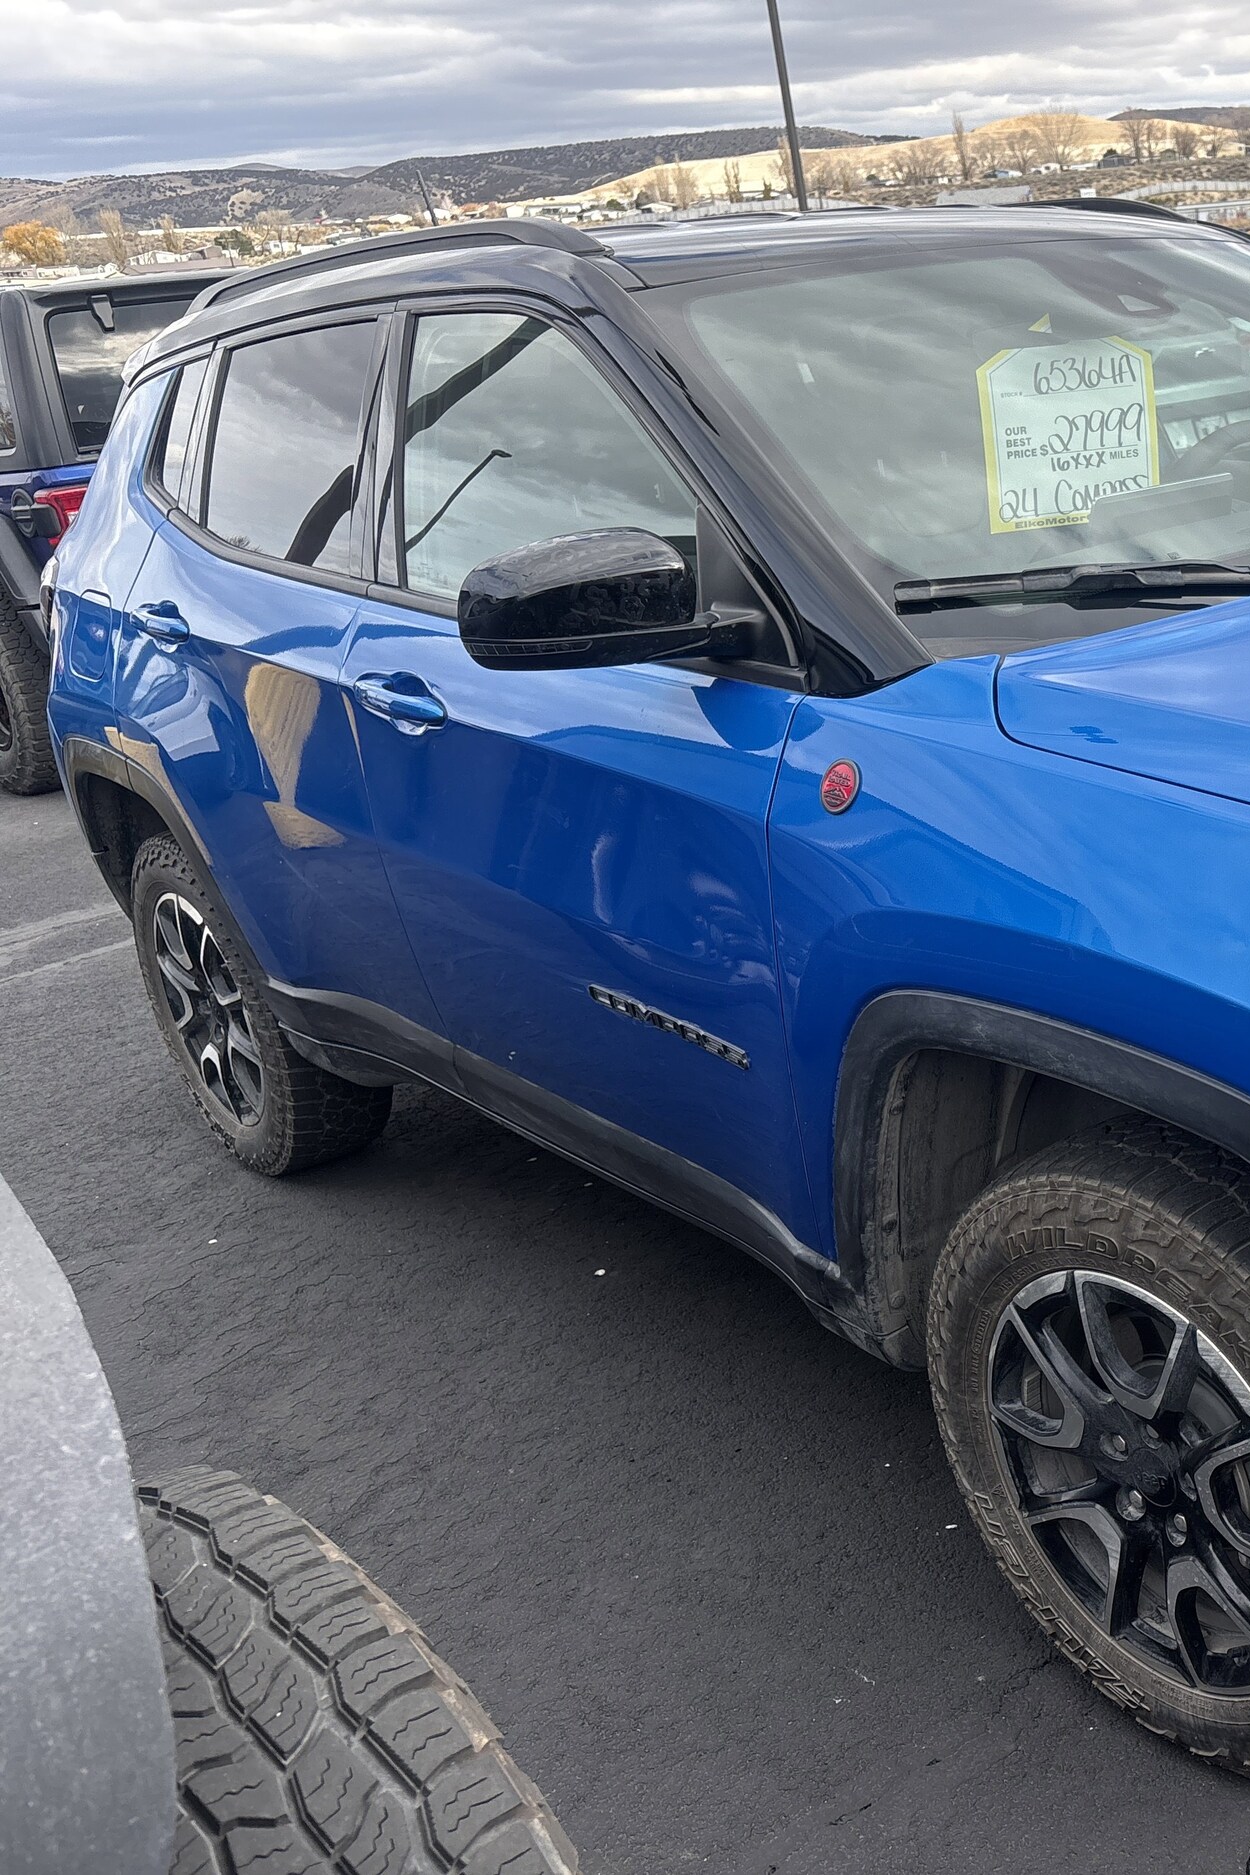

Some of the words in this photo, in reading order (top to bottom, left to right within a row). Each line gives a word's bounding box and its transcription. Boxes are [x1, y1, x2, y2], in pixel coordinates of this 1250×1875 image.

[1033, 354, 1137, 395] 65364A
[1005, 426, 1027, 437] OUR
[1006, 437, 1032, 448] BEST
[1007, 448, 1038, 460] PRICE
[1109, 448, 1139, 460] MILES
[999, 487, 1038, 523] 24
